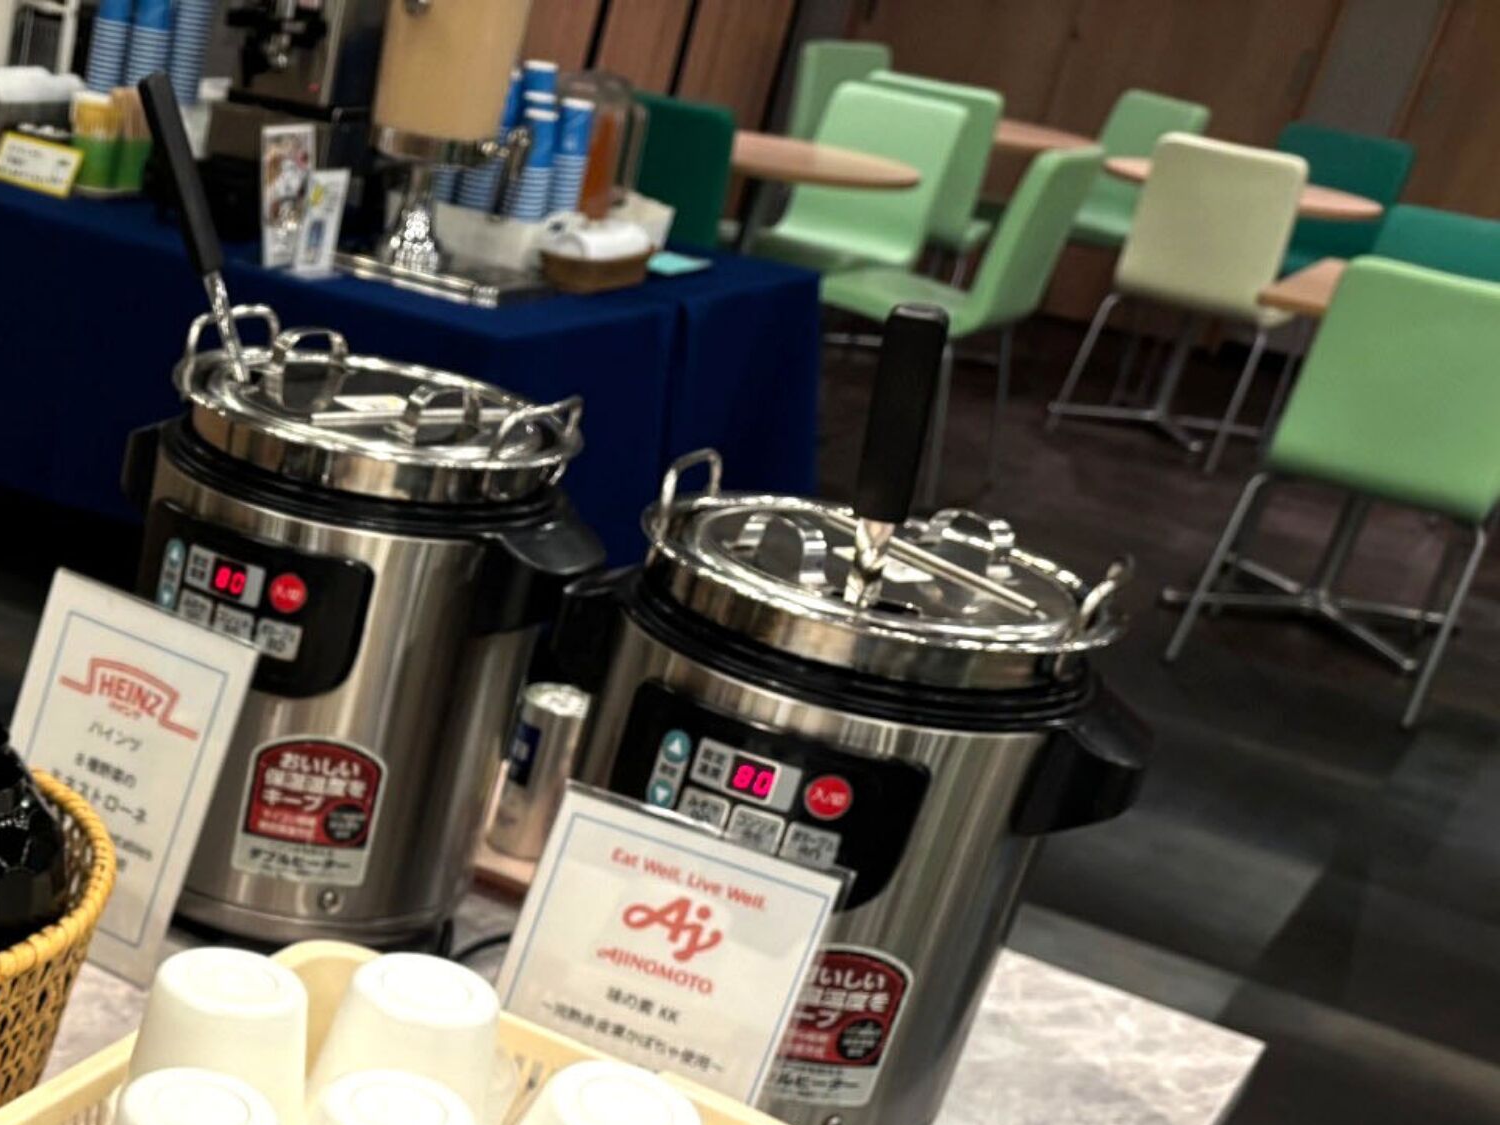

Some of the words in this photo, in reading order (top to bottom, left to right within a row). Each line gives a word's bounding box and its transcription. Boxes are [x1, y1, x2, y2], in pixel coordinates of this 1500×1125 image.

[98, 673, 164, 718] HEINZ
[280, 752, 361, 778] おいしい
[731, 764, 775, 796] 80
[612, 848, 638, 869] Eat
[688, 873, 722, 896] Live
[597, 947, 714, 994] AJINOMOTO
[606, 986, 654, 1016] 味の素
